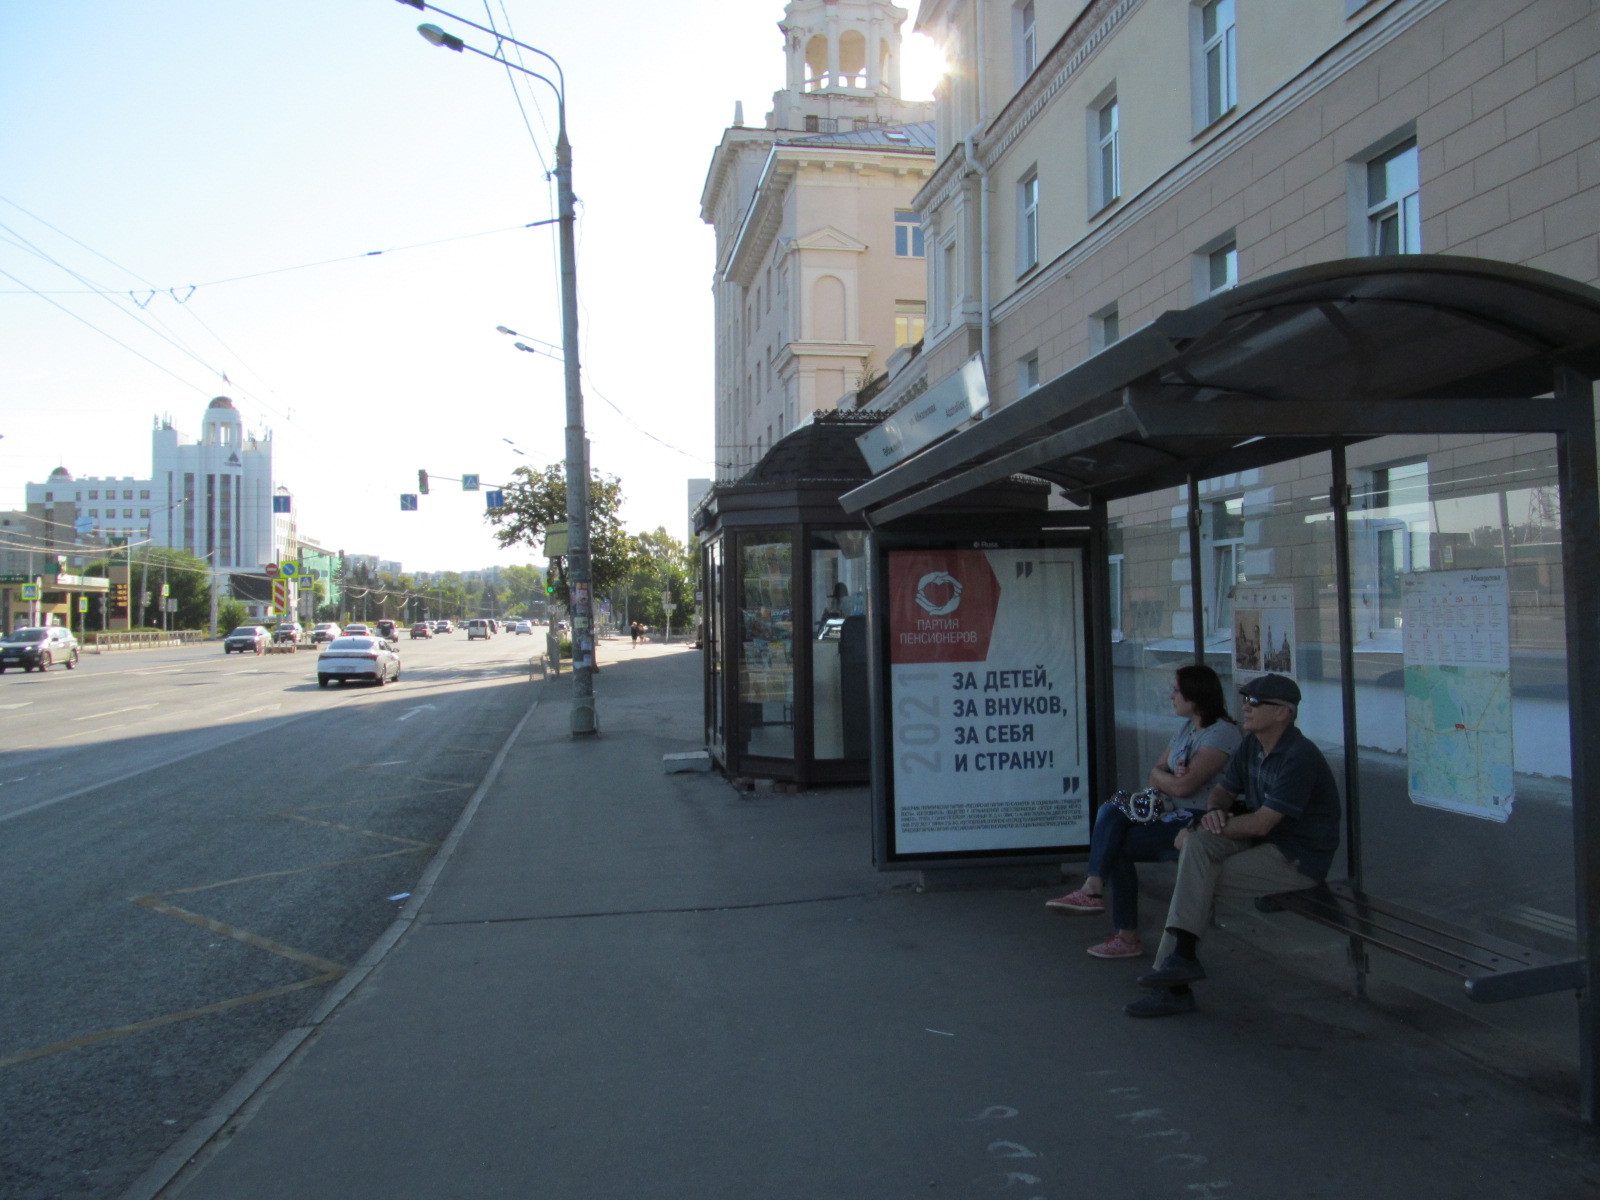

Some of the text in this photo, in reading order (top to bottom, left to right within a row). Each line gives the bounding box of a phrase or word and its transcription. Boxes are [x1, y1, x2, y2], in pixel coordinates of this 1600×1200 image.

[917, 618, 960, 631] ПАРТИЯ
[900, 631, 978, 645] ПЕНСИОНЕРОВ
[952, 664, 1053, 692] ЗА ДЕТЕЙ,
[953, 695, 1067, 717] ЗА ВНУКОВ,
[899, 672, 941, 774] 2021
[954, 723, 1034, 744] ЗА СЕБЯ
[955, 750, 1054, 772] И СТРАНУ!
